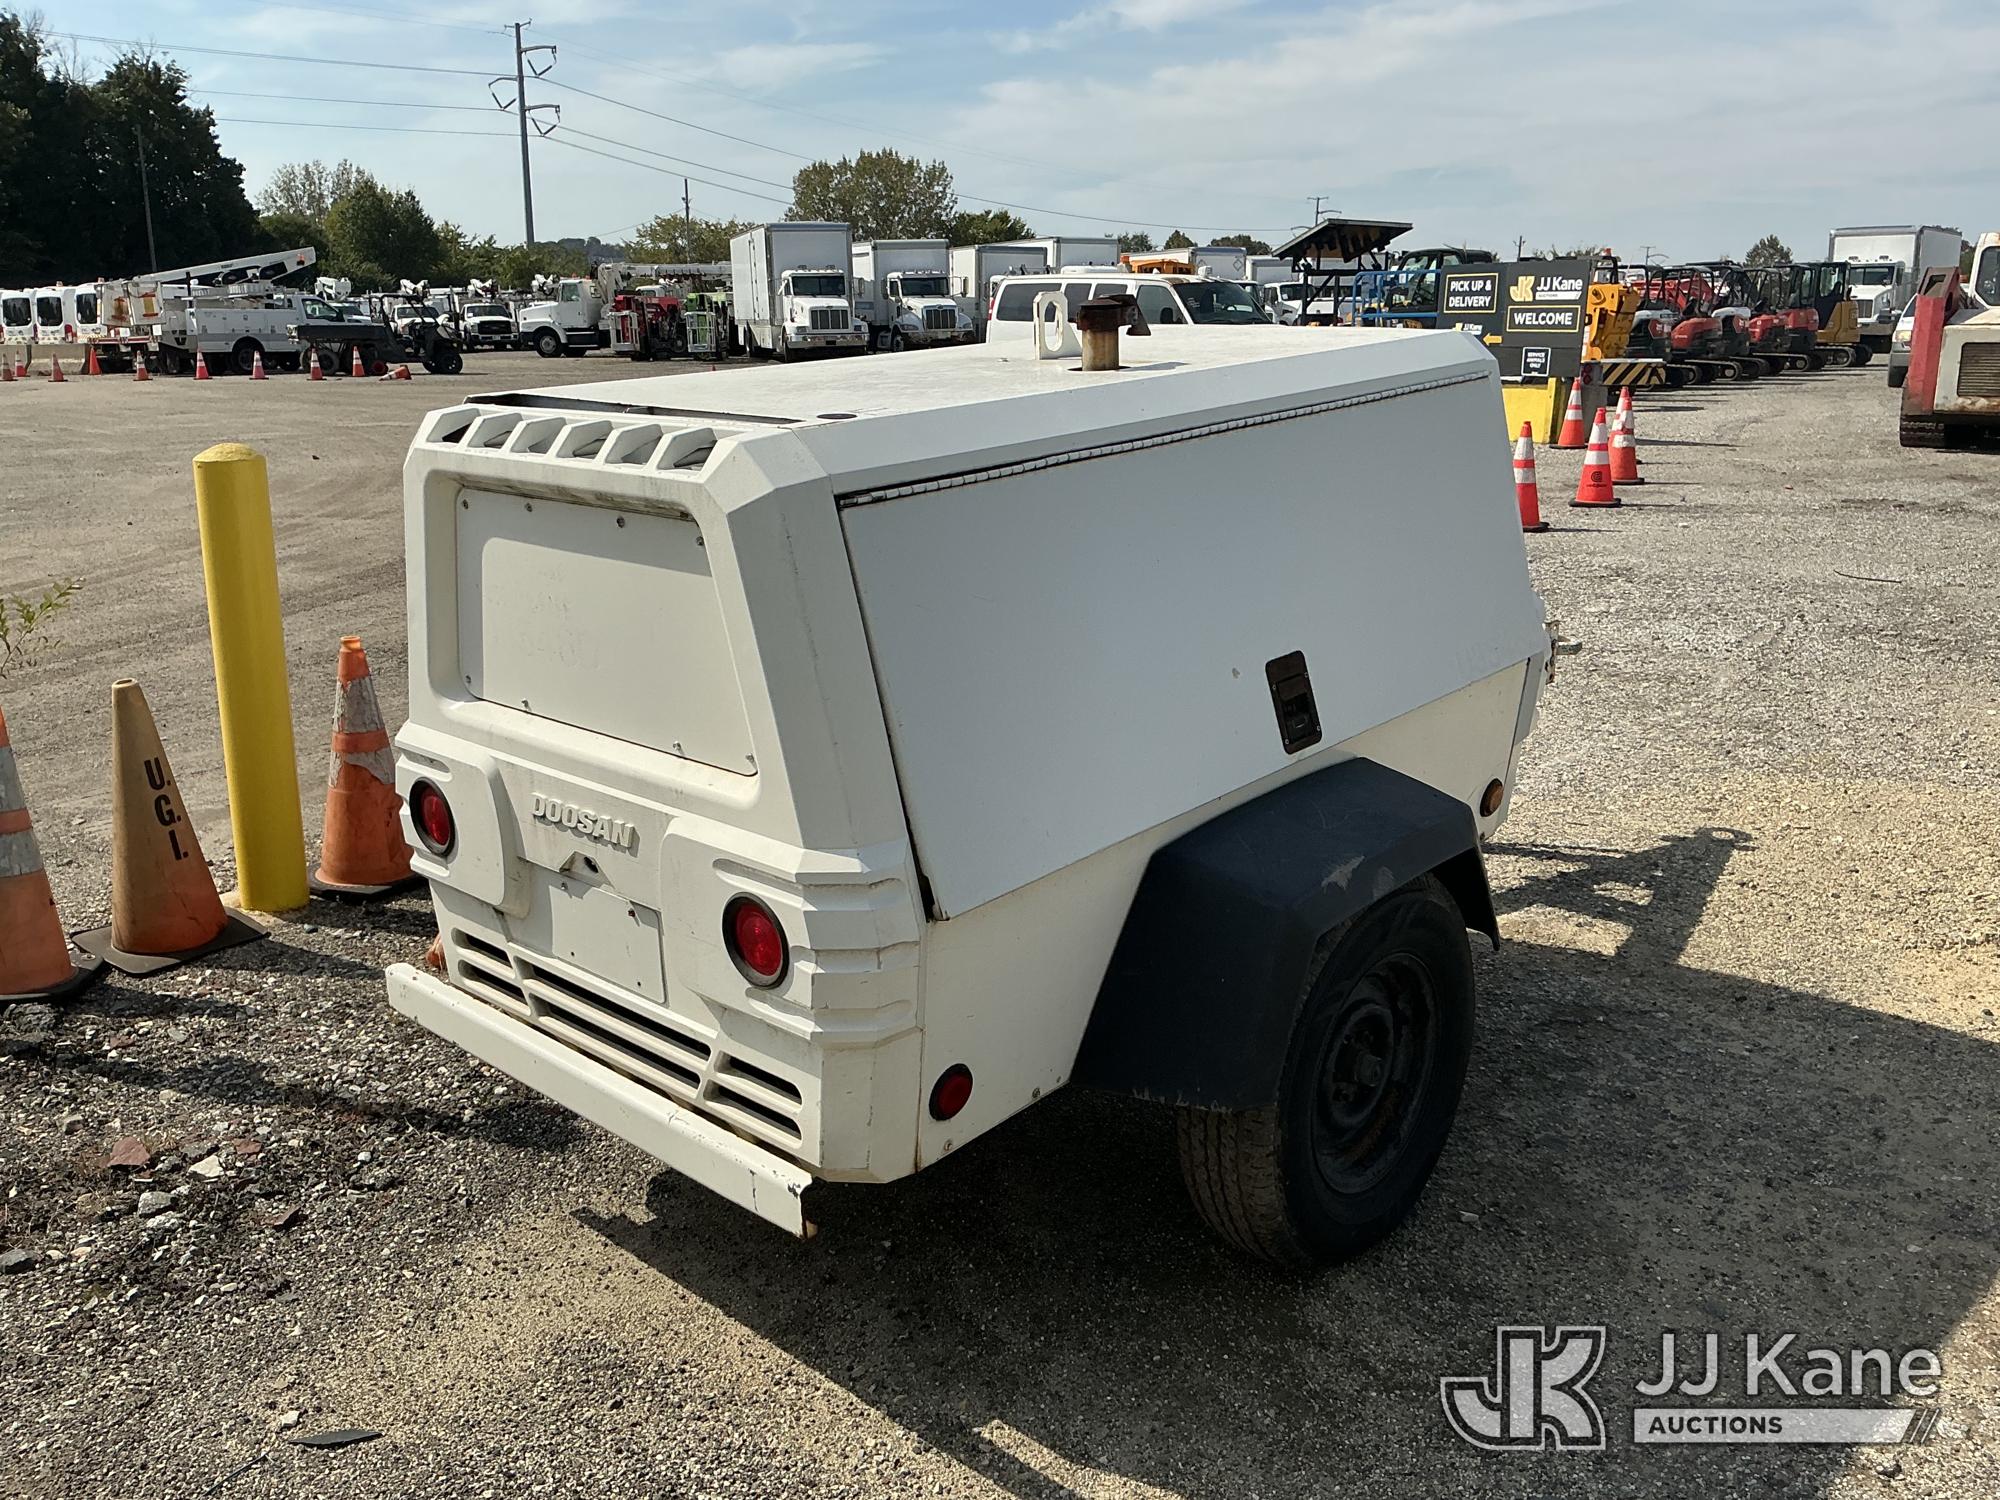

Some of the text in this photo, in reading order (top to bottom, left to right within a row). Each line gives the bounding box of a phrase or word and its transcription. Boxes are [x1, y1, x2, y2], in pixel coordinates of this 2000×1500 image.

[1450, 279, 1492, 292] PICK UP &
[1536, 276, 1583, 291] JJ Kane
[1449, 296, 1492, 307] DELIVERY
[1514, 312, 1573, 325] WELCOME
[531, 792, 635, 848] DOOSAN
